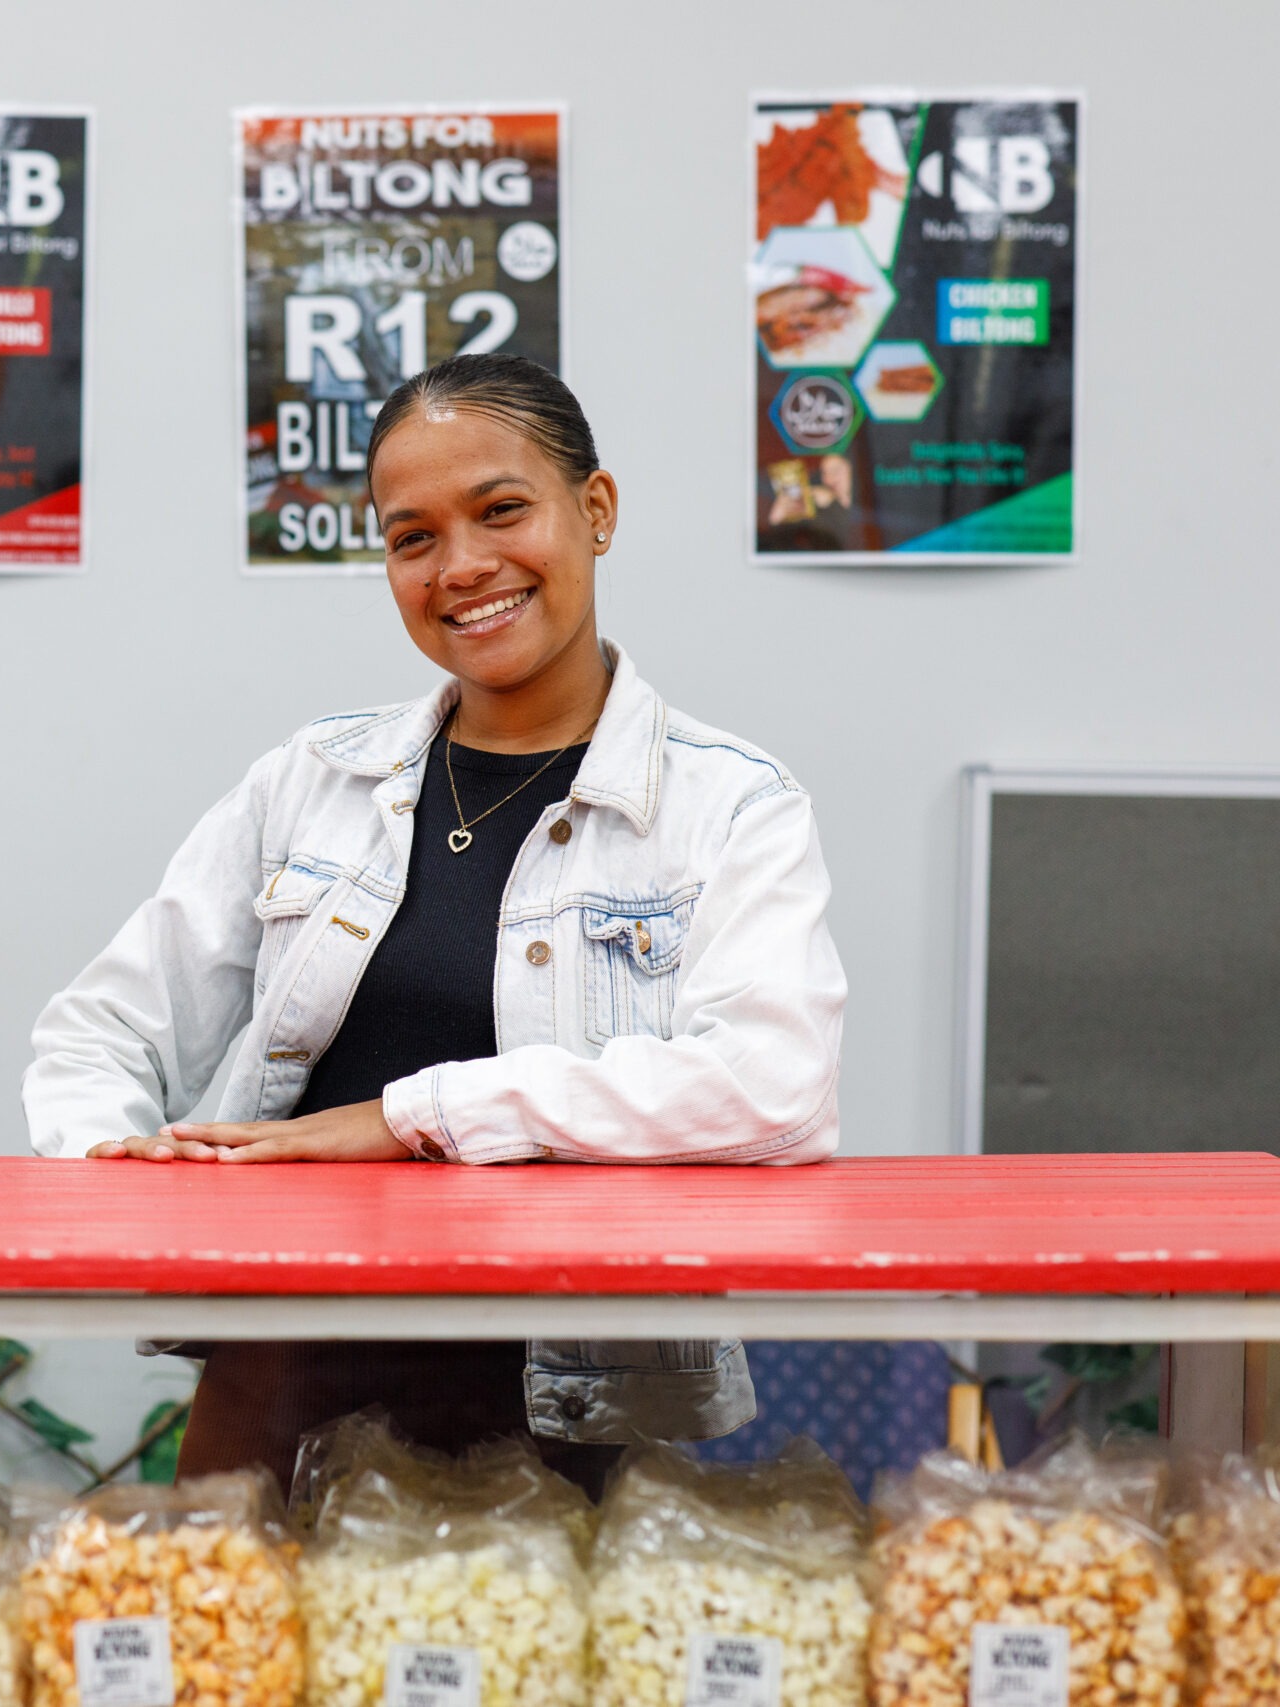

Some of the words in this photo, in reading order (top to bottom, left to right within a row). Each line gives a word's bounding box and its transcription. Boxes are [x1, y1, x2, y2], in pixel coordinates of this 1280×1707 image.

[301, 118, 408, 149] NUTS
[411, 117, 495, 148] FOR
[261, 157, 532, 210] BILTONG
[321, 236, 475, 279] FROM
[285, 290, 519, 383] R12
